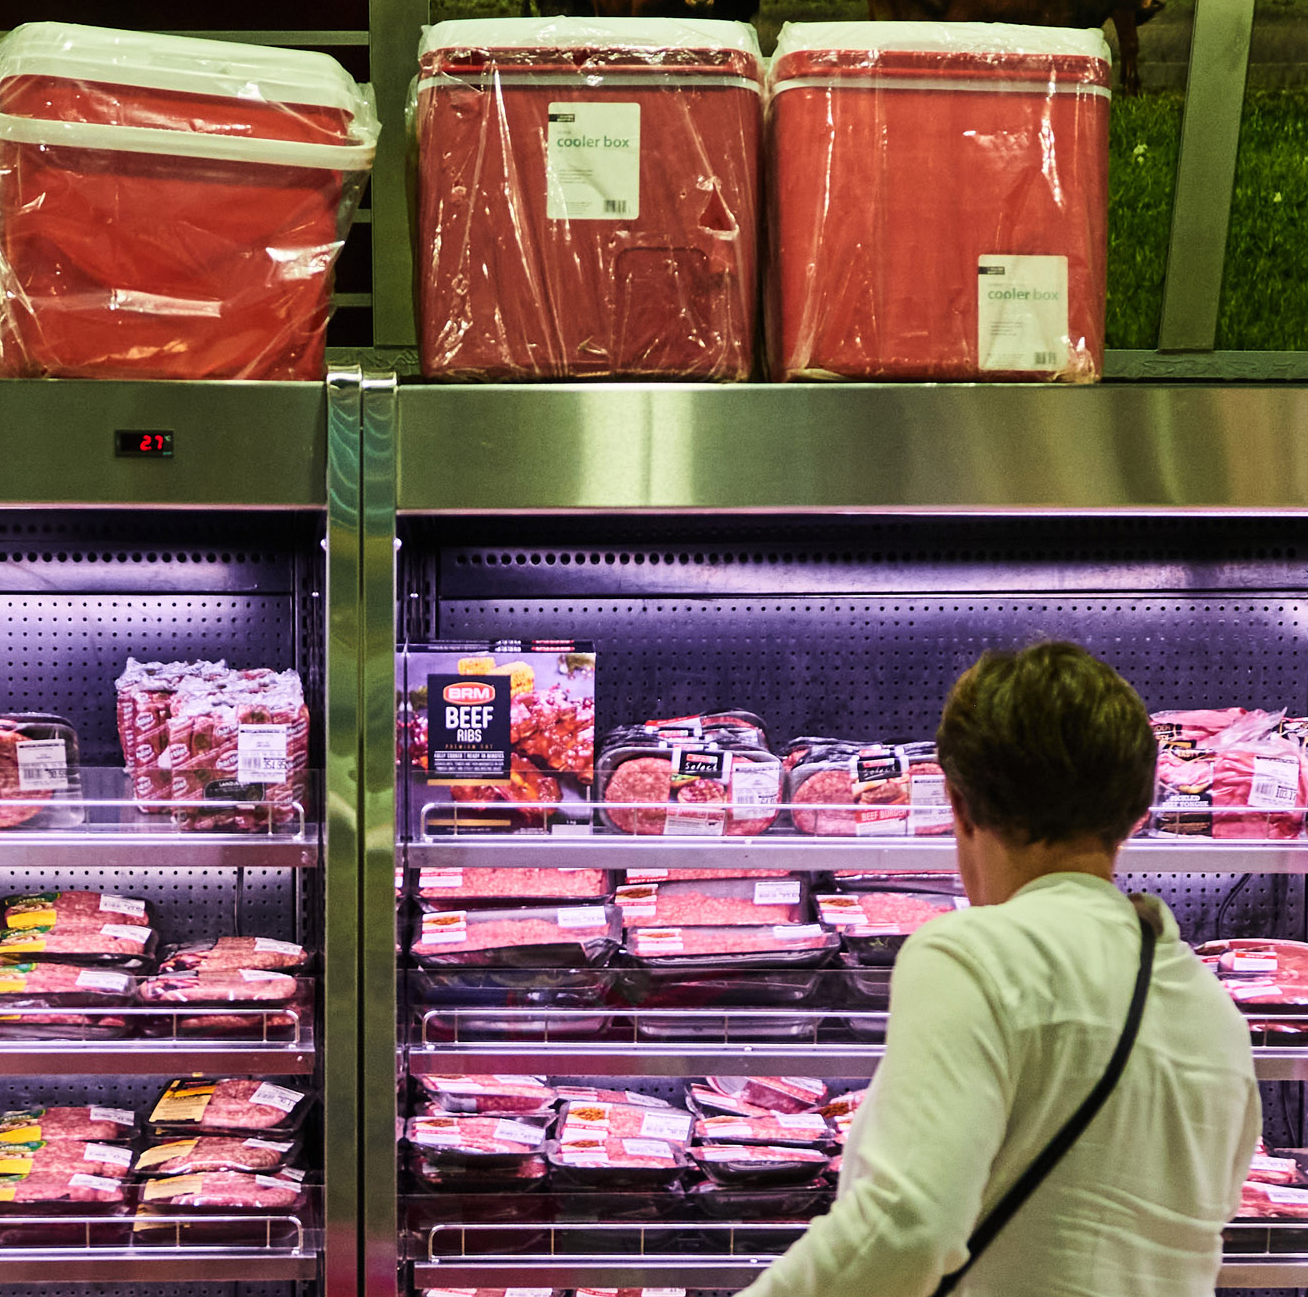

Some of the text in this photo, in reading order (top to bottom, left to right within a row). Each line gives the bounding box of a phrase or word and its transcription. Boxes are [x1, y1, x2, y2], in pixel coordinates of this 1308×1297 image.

[556, 135, 630, 148] cooler box
[987, 287, 1059, 301] cooler box
[447, 686, 491, 700] BRM
[445, 706, 493, 729] BEEF
[456, 729, 482, 743] RIBS
[685, 762, 718, 772] Select
[861, 811, 878, 822] BEEF
